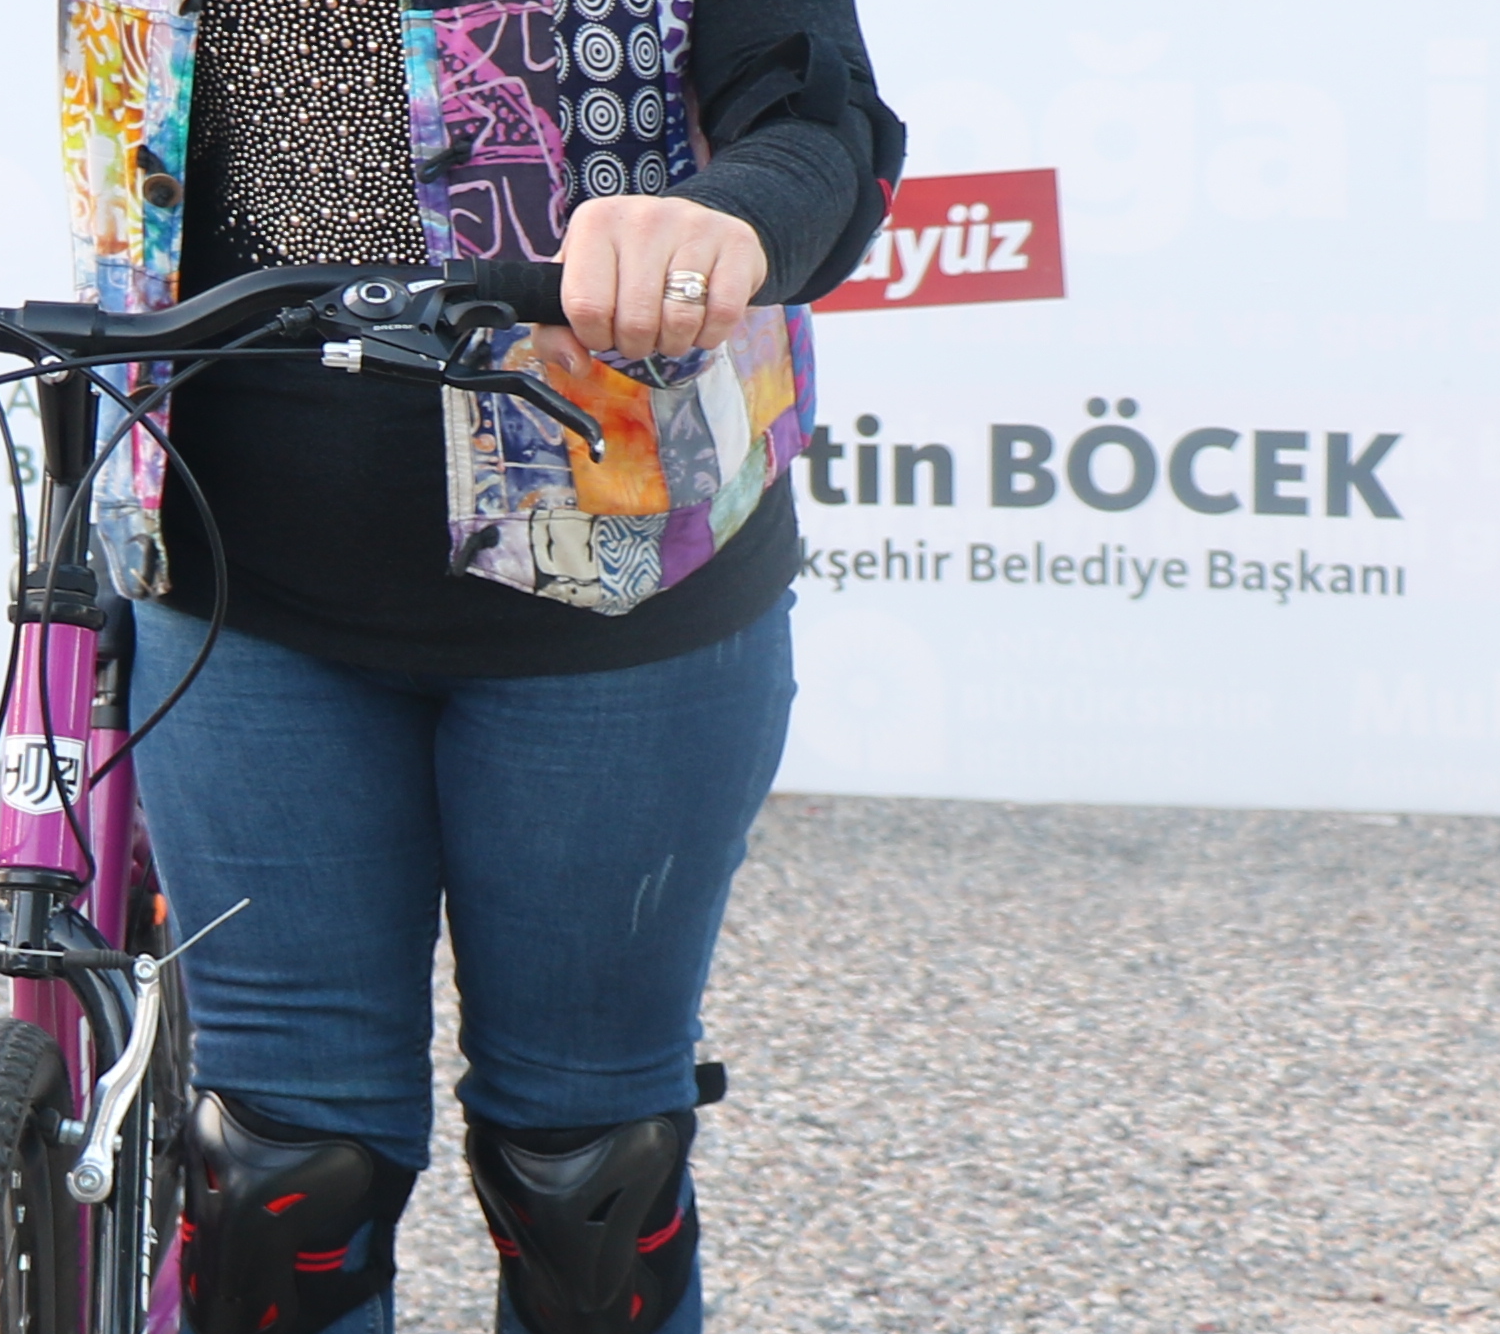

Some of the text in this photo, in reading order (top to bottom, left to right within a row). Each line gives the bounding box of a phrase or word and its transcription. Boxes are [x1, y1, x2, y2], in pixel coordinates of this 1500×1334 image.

[989, 396, 1405, 520] BÖCEK
[969, 542, 1190, 602] Belediye
[1207, 549, 1406, 605] Başkanı
